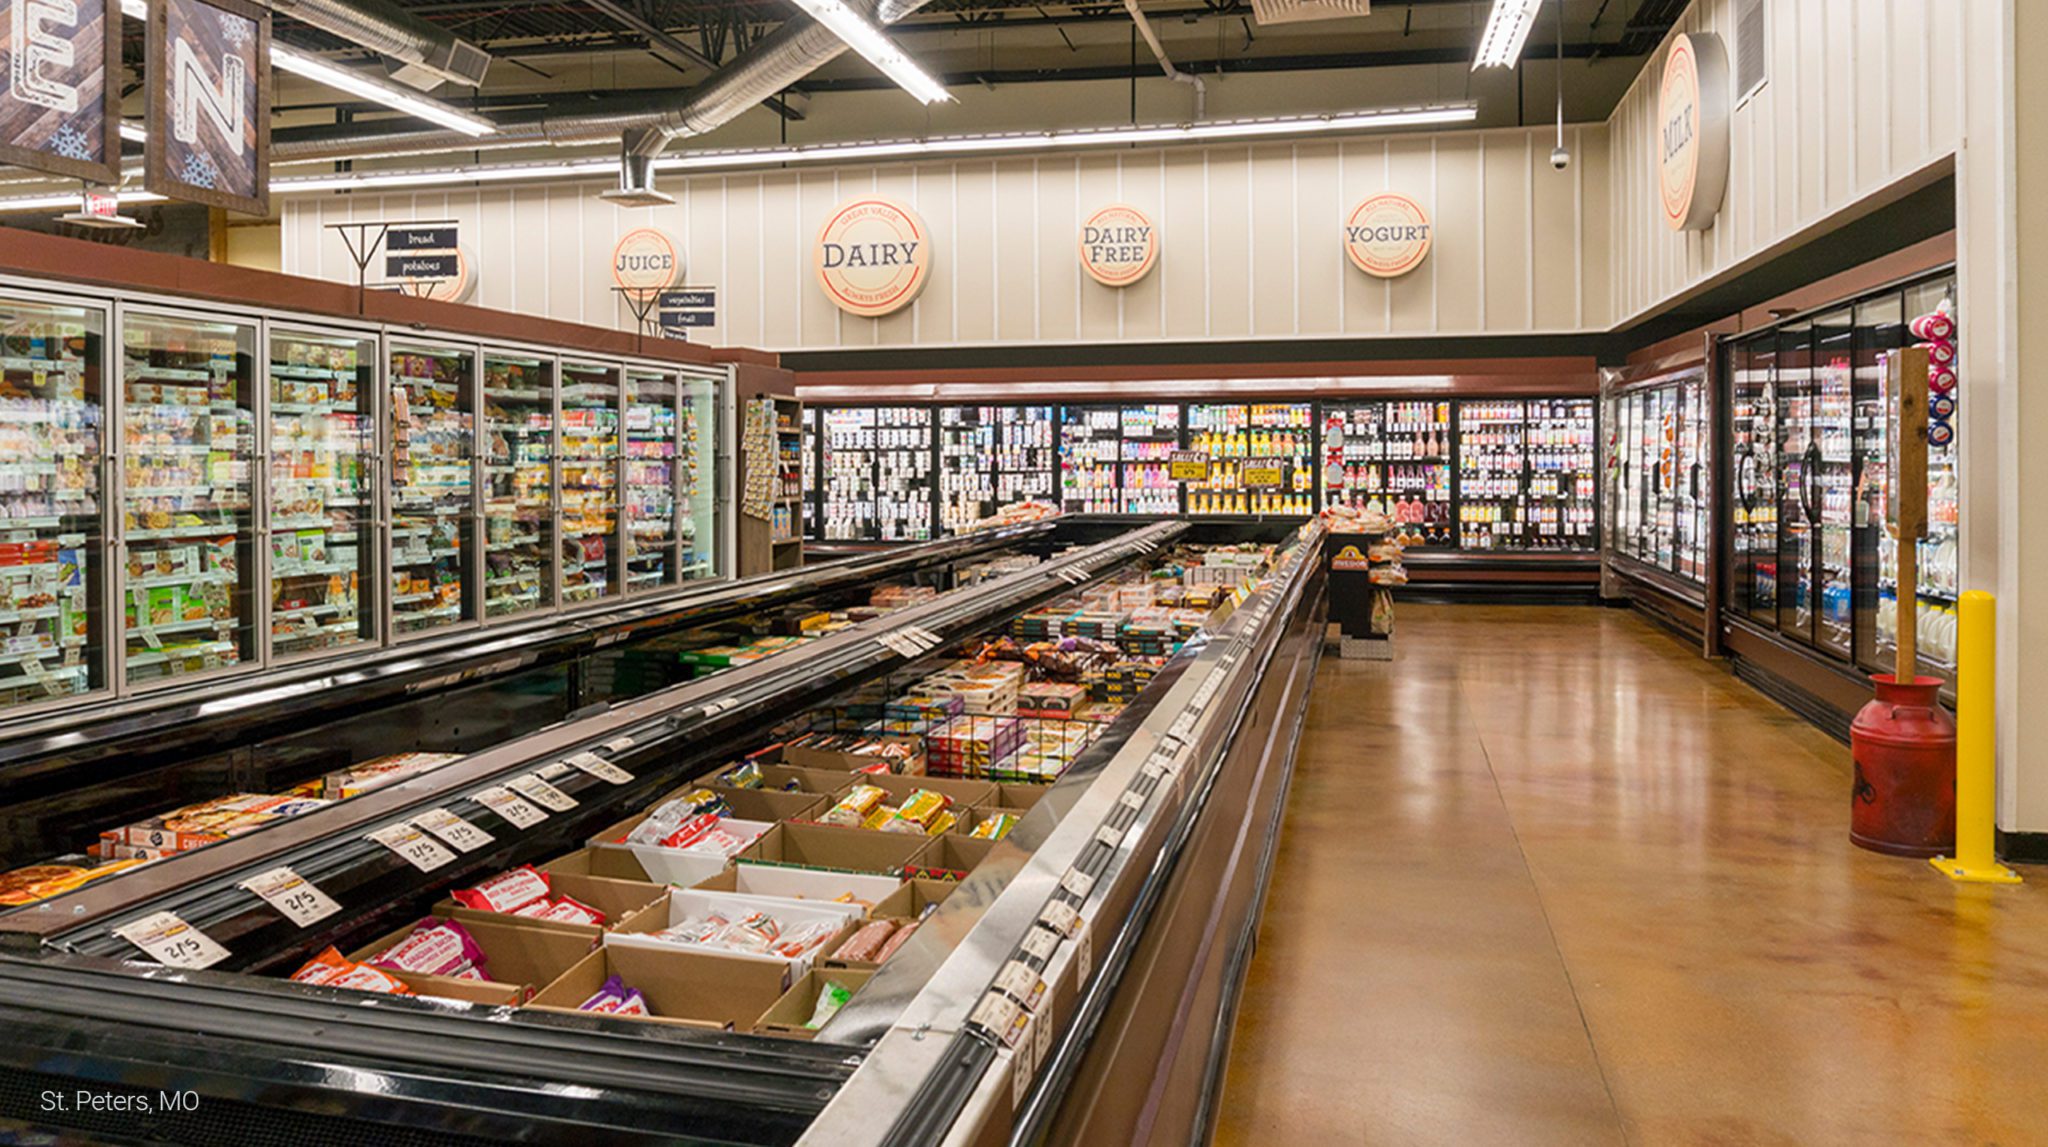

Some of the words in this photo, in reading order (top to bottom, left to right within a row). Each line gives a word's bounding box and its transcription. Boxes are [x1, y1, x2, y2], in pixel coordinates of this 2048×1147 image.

[1663, 104, 1692, 164] MILK
[408, 232, 435, 245] bread
[1084, 227, 1151, 244] DAIRY
[1346, 225, 1430, 243] YOGURT
[616, 254, 672, 271] JUICE
[823, 242, 918, 268] DAIRY
[1091, 245, 1144, 263] FREE
[403, 261, 440, 276] potatoes
[506, 803, 529, 818] 2/5
[447, 826, 473, 841] 2/5
[408, 842, 435, 859] 2/5
[285, 891, 316, 911] 2/5
[164, 937, 200, 959] 2/5
